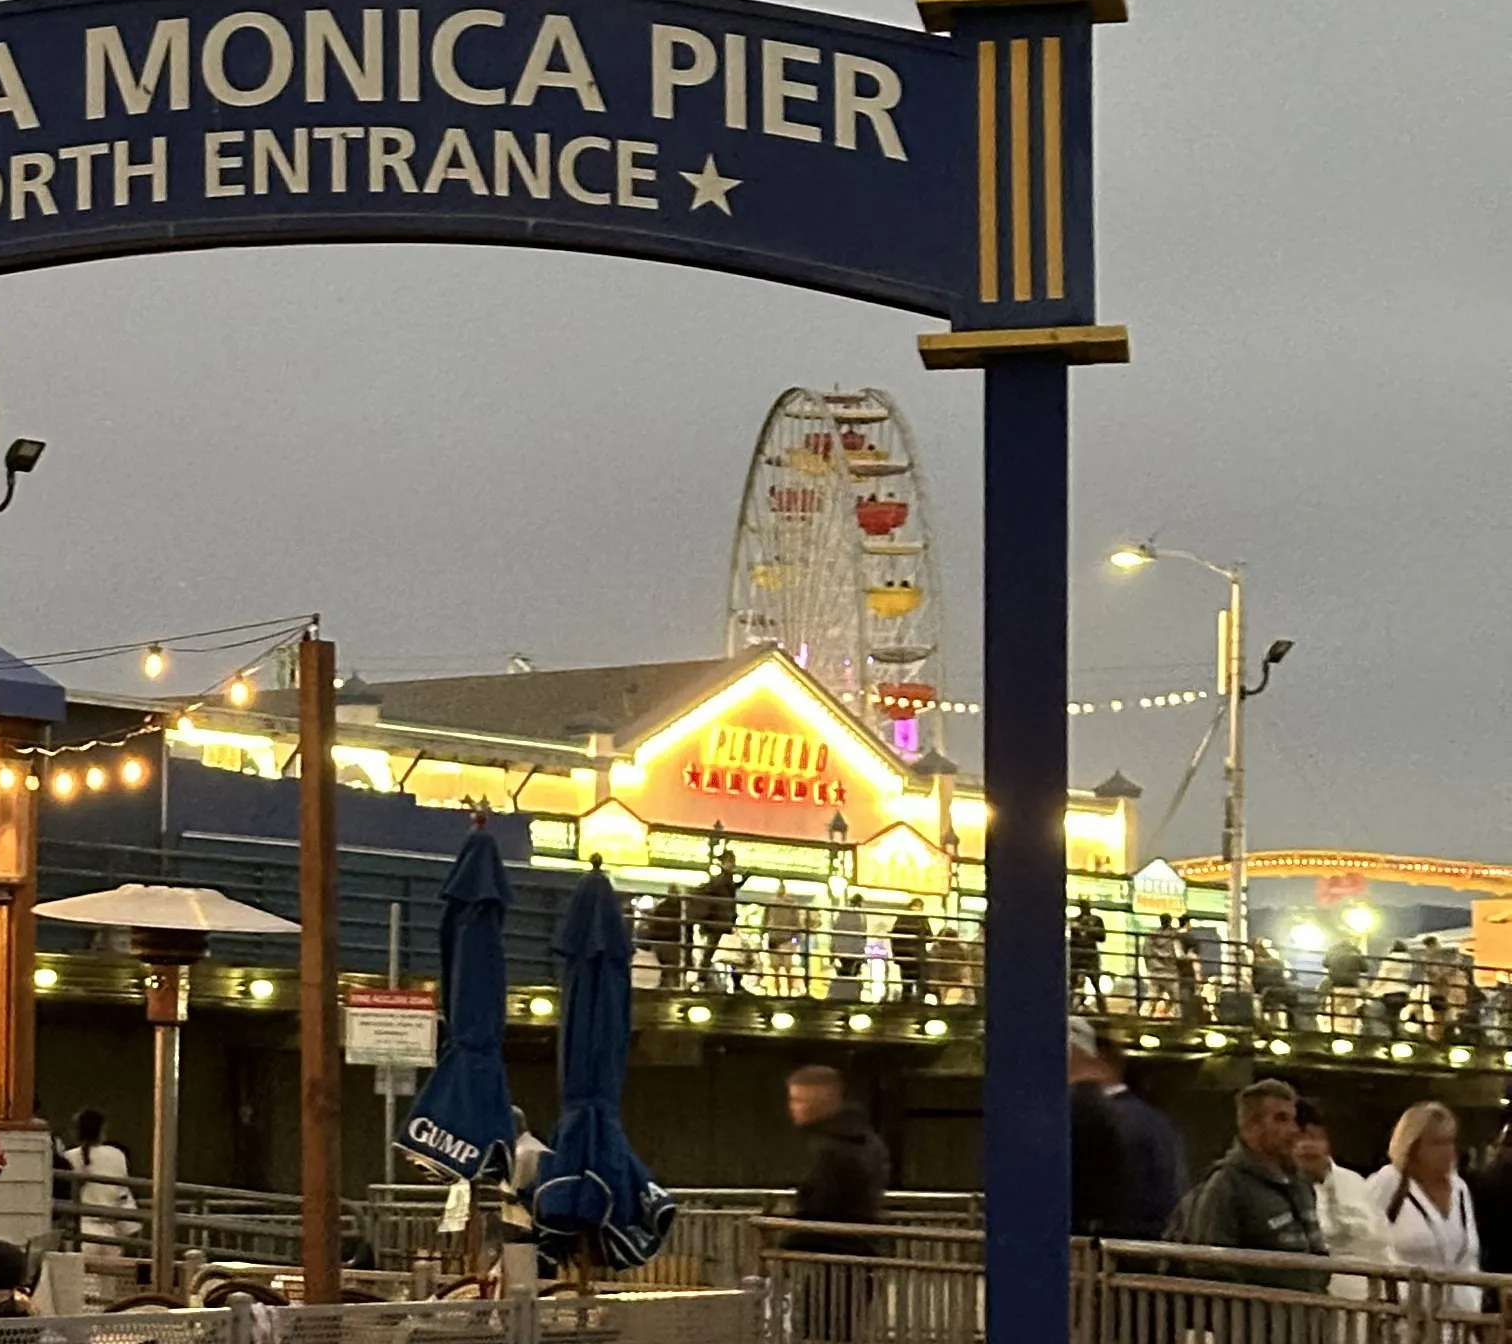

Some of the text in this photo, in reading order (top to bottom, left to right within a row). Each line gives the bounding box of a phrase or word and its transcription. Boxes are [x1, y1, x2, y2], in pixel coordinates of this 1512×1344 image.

[84, 8, 607, 121] MONICA
[650, 22, 909, 163] PIER
[204, 126, 660, 211] ENTRANCE
[408, 1116, 480, 1164] GUMP
